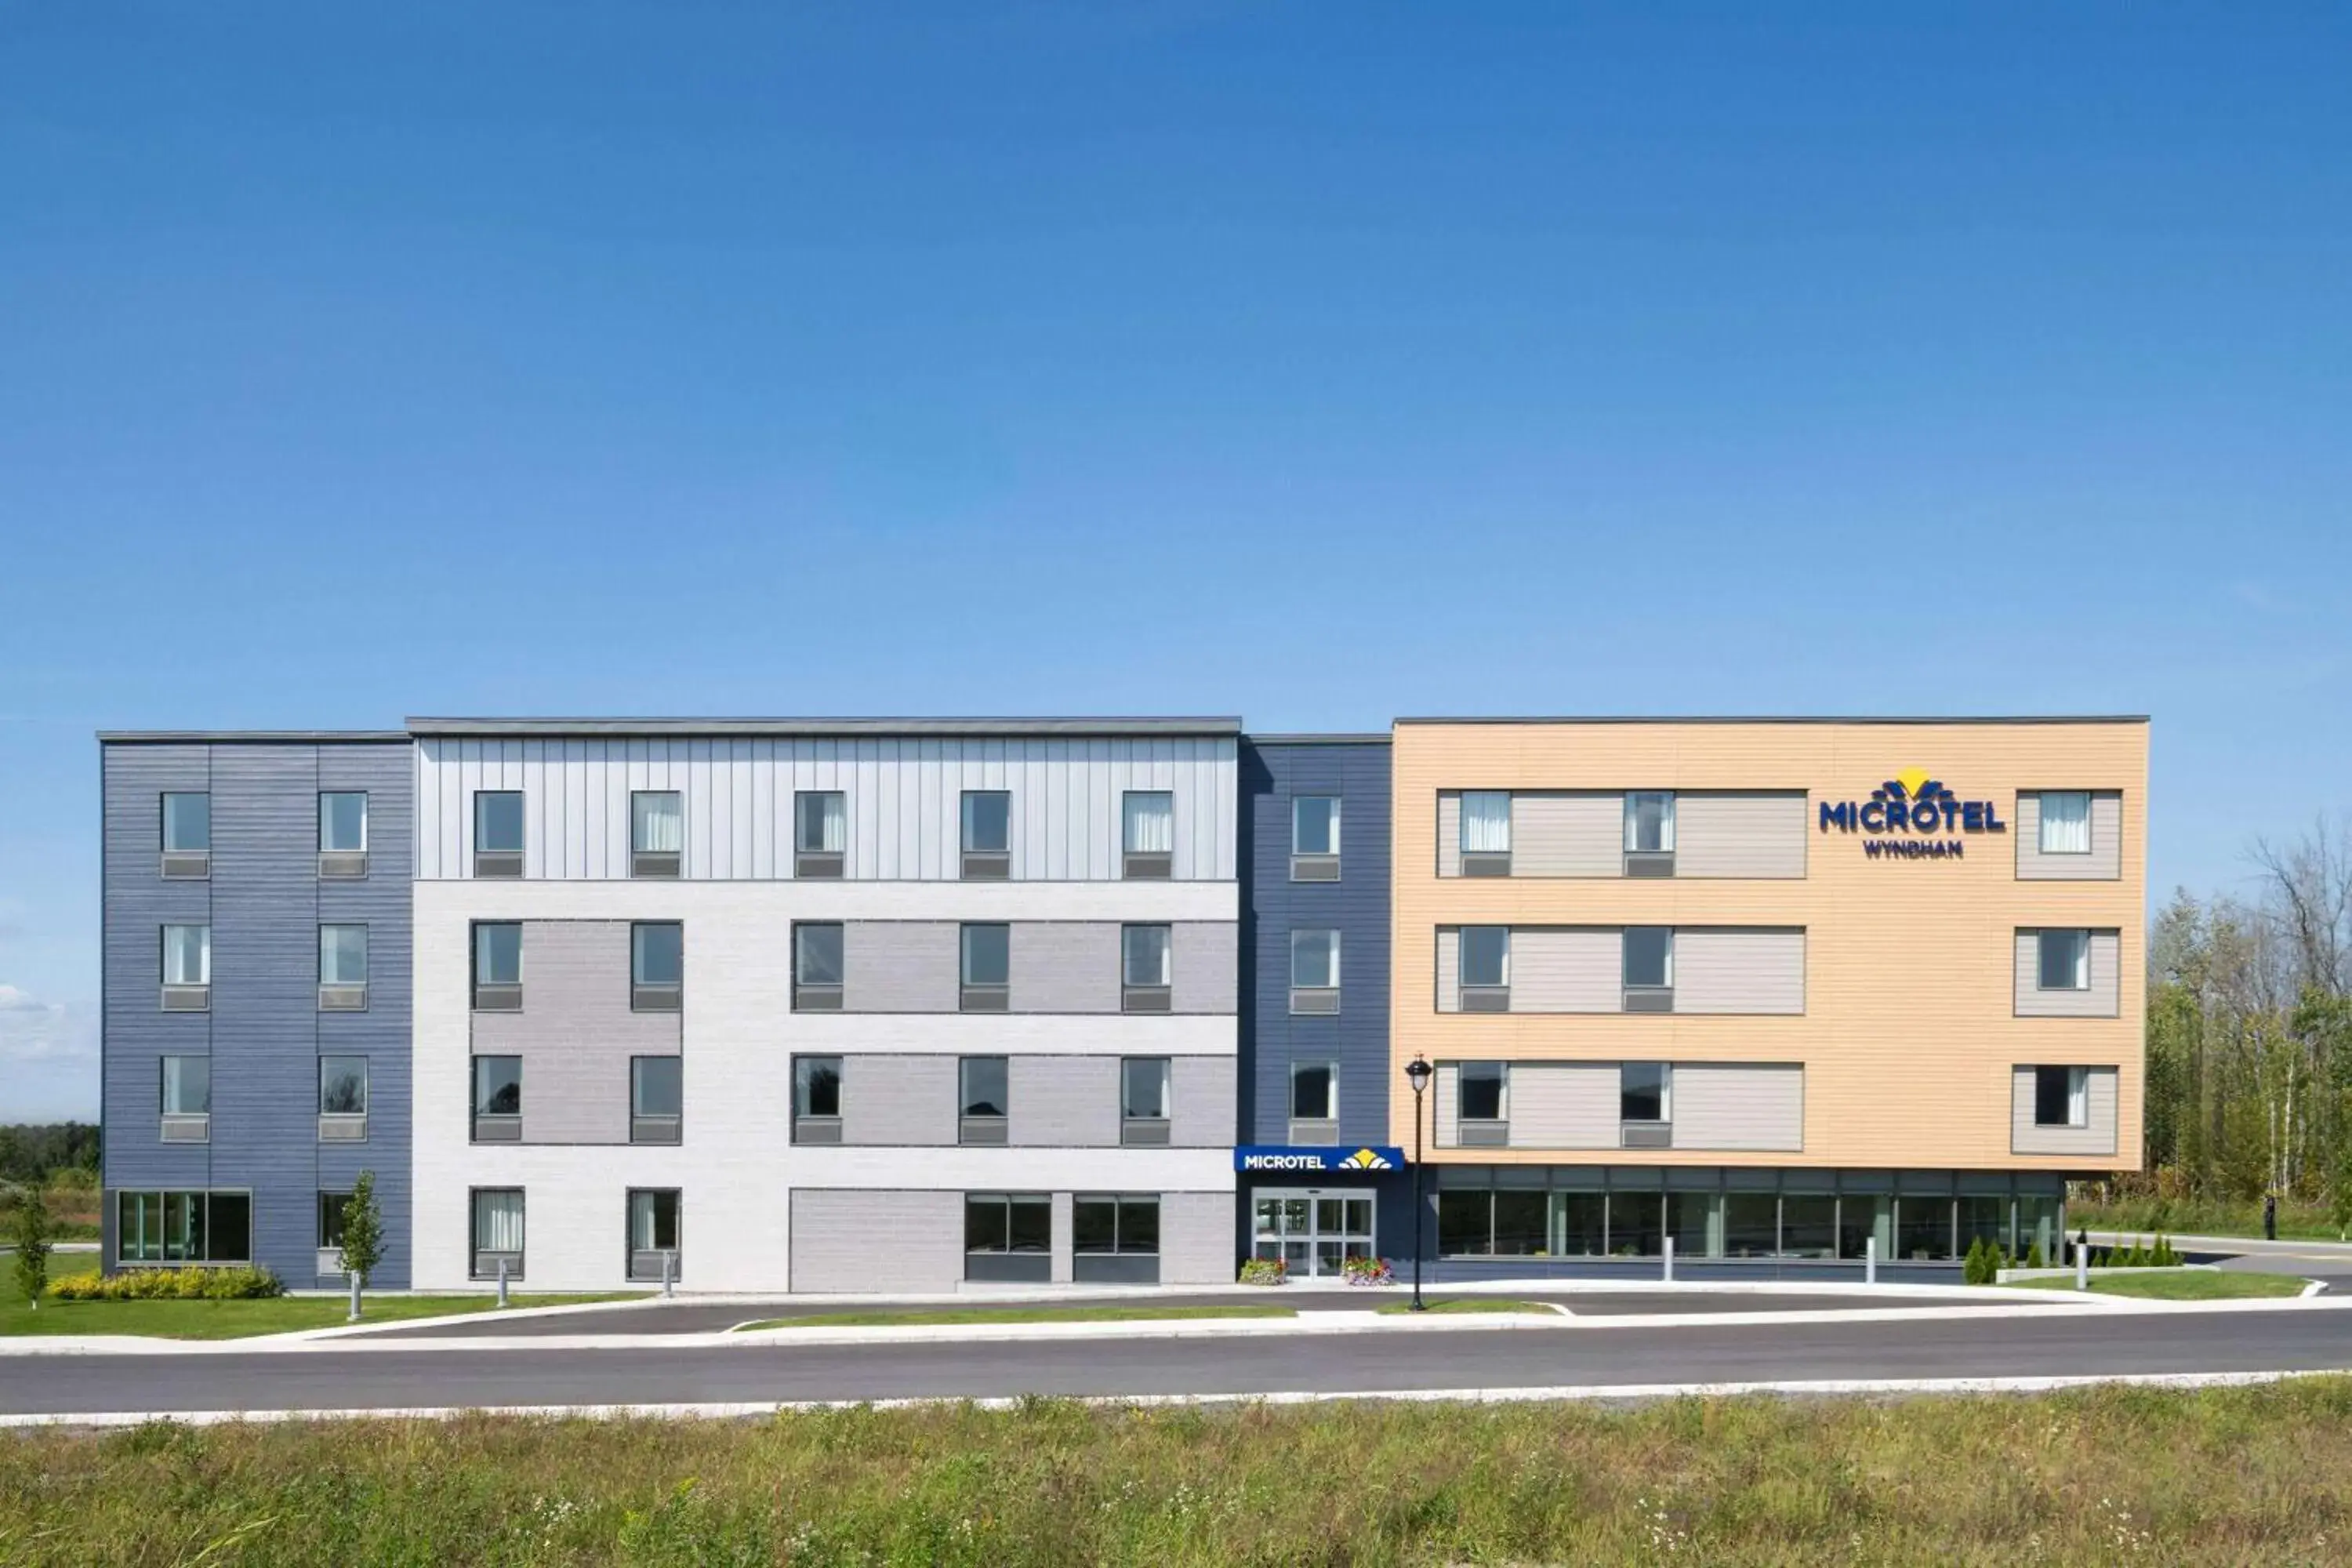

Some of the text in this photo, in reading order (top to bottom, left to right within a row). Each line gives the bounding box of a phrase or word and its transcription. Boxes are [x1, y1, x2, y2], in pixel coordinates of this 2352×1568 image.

[1820, 800, 2006, 833] MICROTEL
[1863, 840, 1963, 859] WYNDHAM
[1244, 1156, 1327, 1170] MICROTEL
